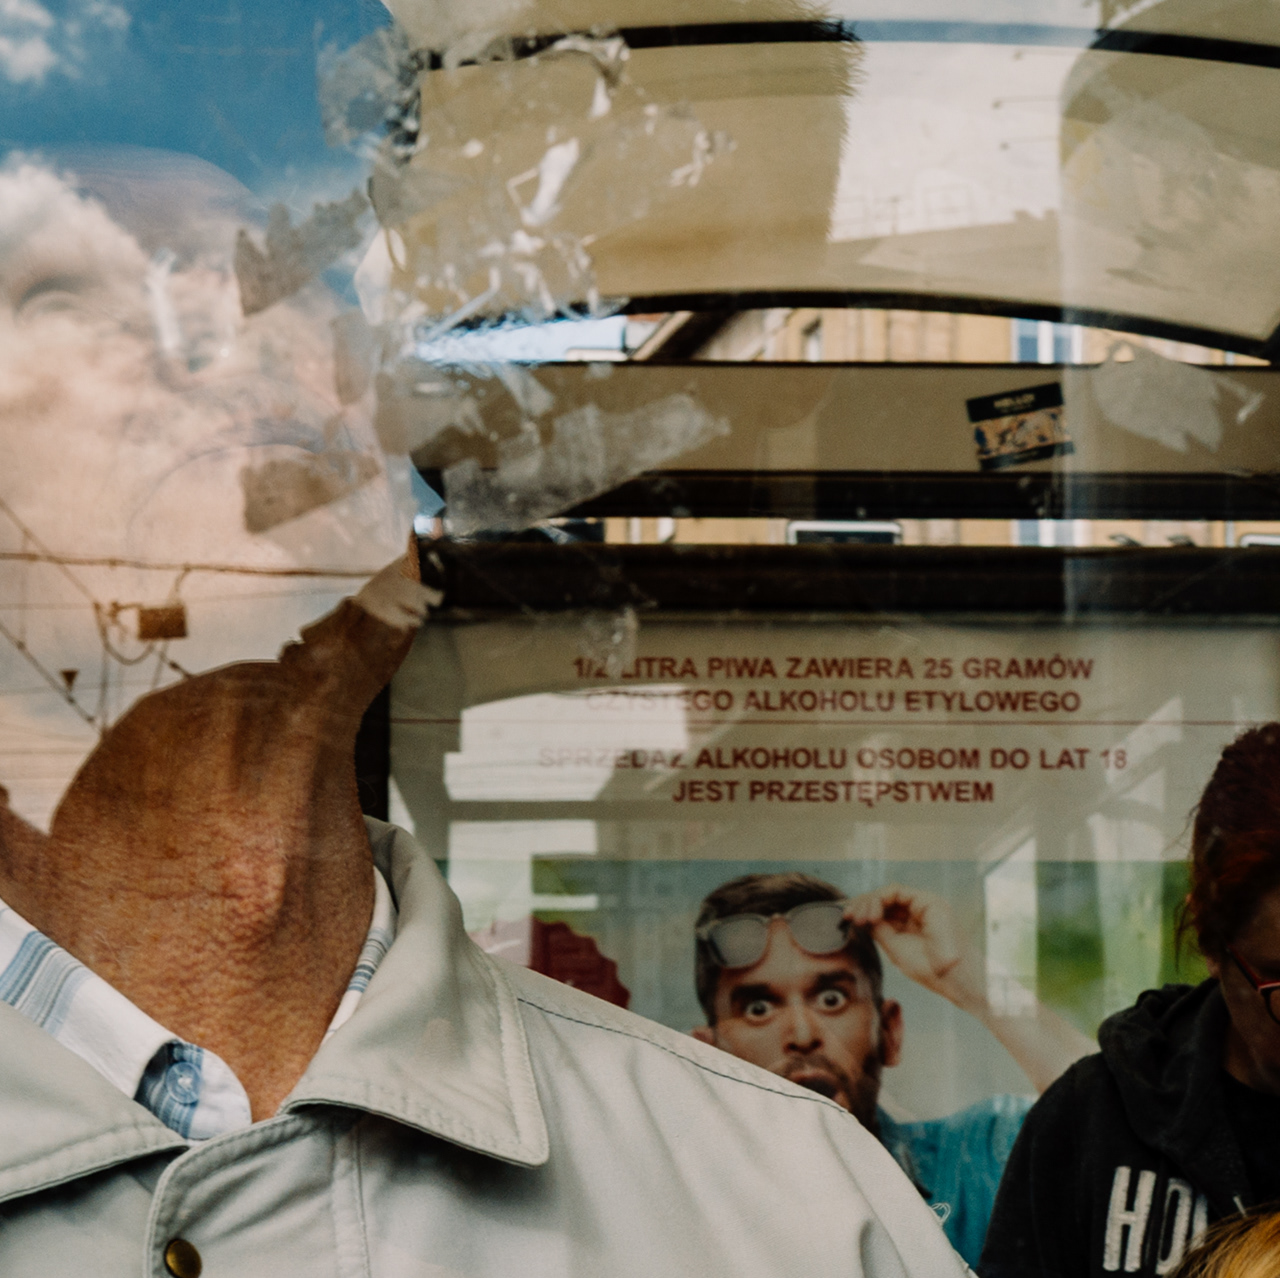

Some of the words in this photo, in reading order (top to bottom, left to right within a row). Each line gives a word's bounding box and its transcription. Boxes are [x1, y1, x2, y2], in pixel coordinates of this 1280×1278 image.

[707, 656, 777, 679] PIWA
[785, 656, 914, 679] ZAWIERA
[923, 657, 954, 679] 25
[961, 652, 1094, 680] GRAMÓW
[744, 689, 896, 712] ALKOHOLU
[904, 689, 1081, 712] ETYLOWEGO
[694, 747, 847, 769] ALKOHOLU
[856, 747, 981, 770] OSOBOM
[989, 747, 1030, 770] DO
[1039, 748, 1090, 769] LAT
[1099, 748, 1128, 770] 18
[672, 780, 740, 802] JEST
[748, 780, 995, 808] PRZESTĘPSTWEM
